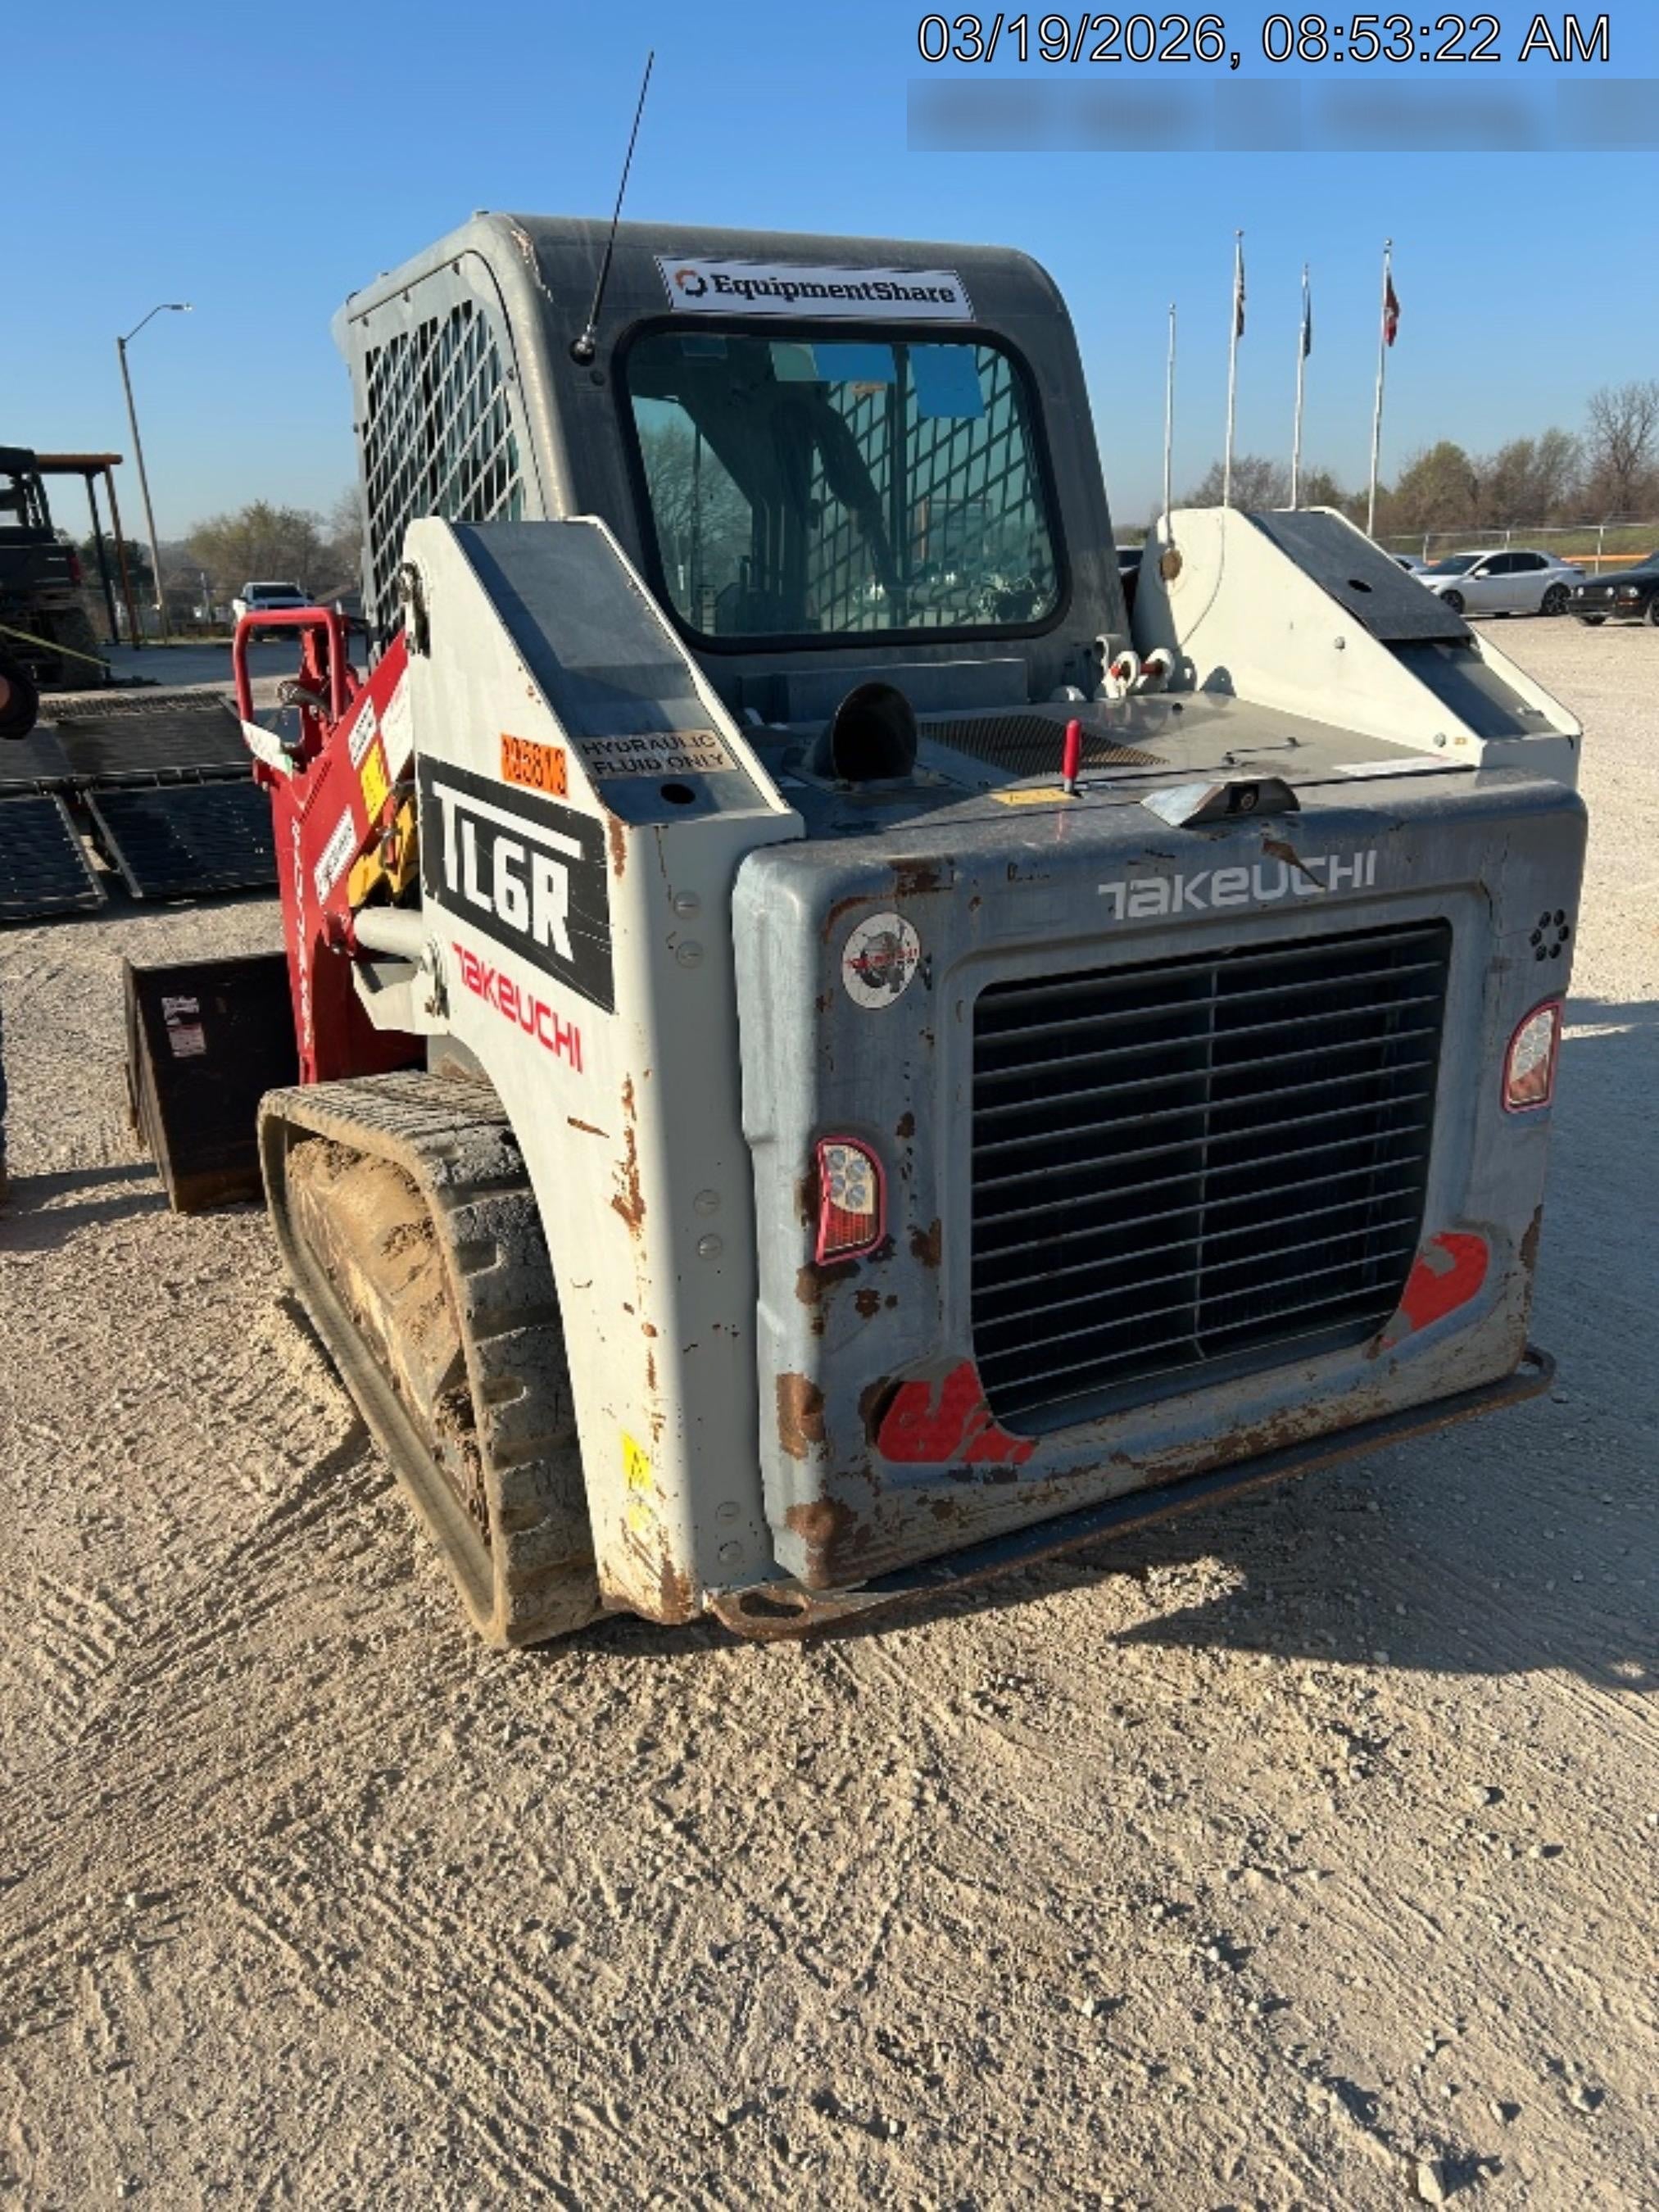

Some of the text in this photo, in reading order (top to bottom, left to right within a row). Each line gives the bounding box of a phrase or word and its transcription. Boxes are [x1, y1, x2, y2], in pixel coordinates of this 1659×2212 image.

[710, 274, 956, 302] EquipmentShare
[582, 734, 716, 756] HYDRAULIC
[592, 752, 724, 775] FLUID ONLY
[433, 781, 582, 964] TL6R
[1098, 849, 1377, 920] TAKEUCHI
[451, 941, 584, 1074] TAKEUCHI
